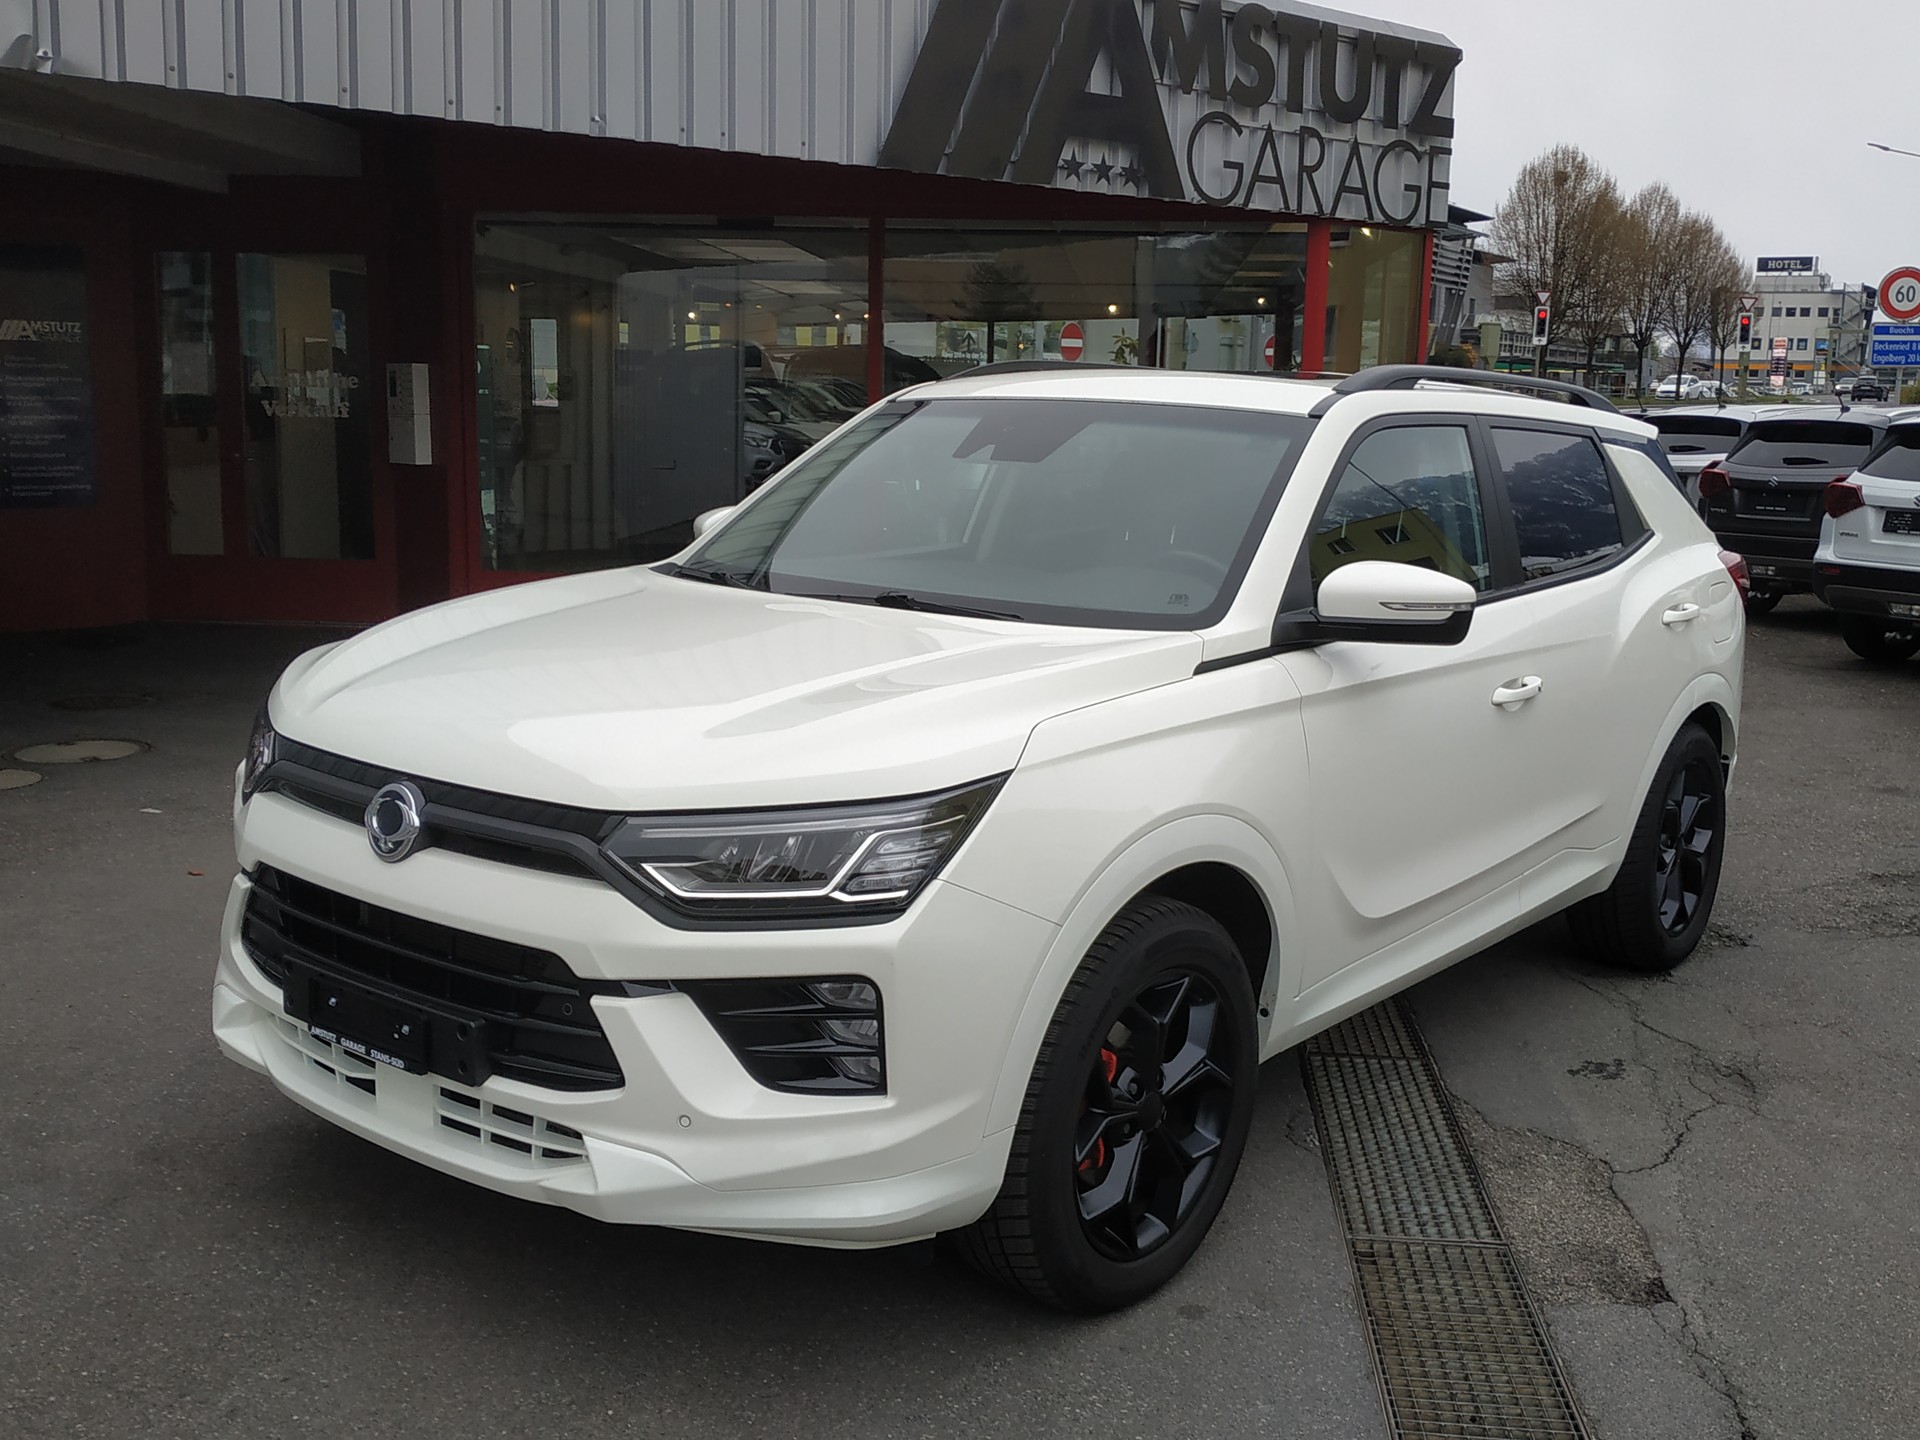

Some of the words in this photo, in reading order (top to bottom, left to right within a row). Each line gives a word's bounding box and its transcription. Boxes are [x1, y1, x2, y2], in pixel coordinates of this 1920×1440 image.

[1187, 110, 1452, 228] GARAGE
[1767, 260, 1803, 269] HOTEL
[1895, 285, 1916, 303] 60
[1912, 342, 1917, 351] 8
[1873, 353, 1906, 364] Engelberg
[1908, 353, 1916, 363] 20
[311, 1025, 337, 1043] AMSTUTZ
[340, 1037, 366, 1055] GARAGE
[370, 1049, 405, 1069] STANS-SÜD
